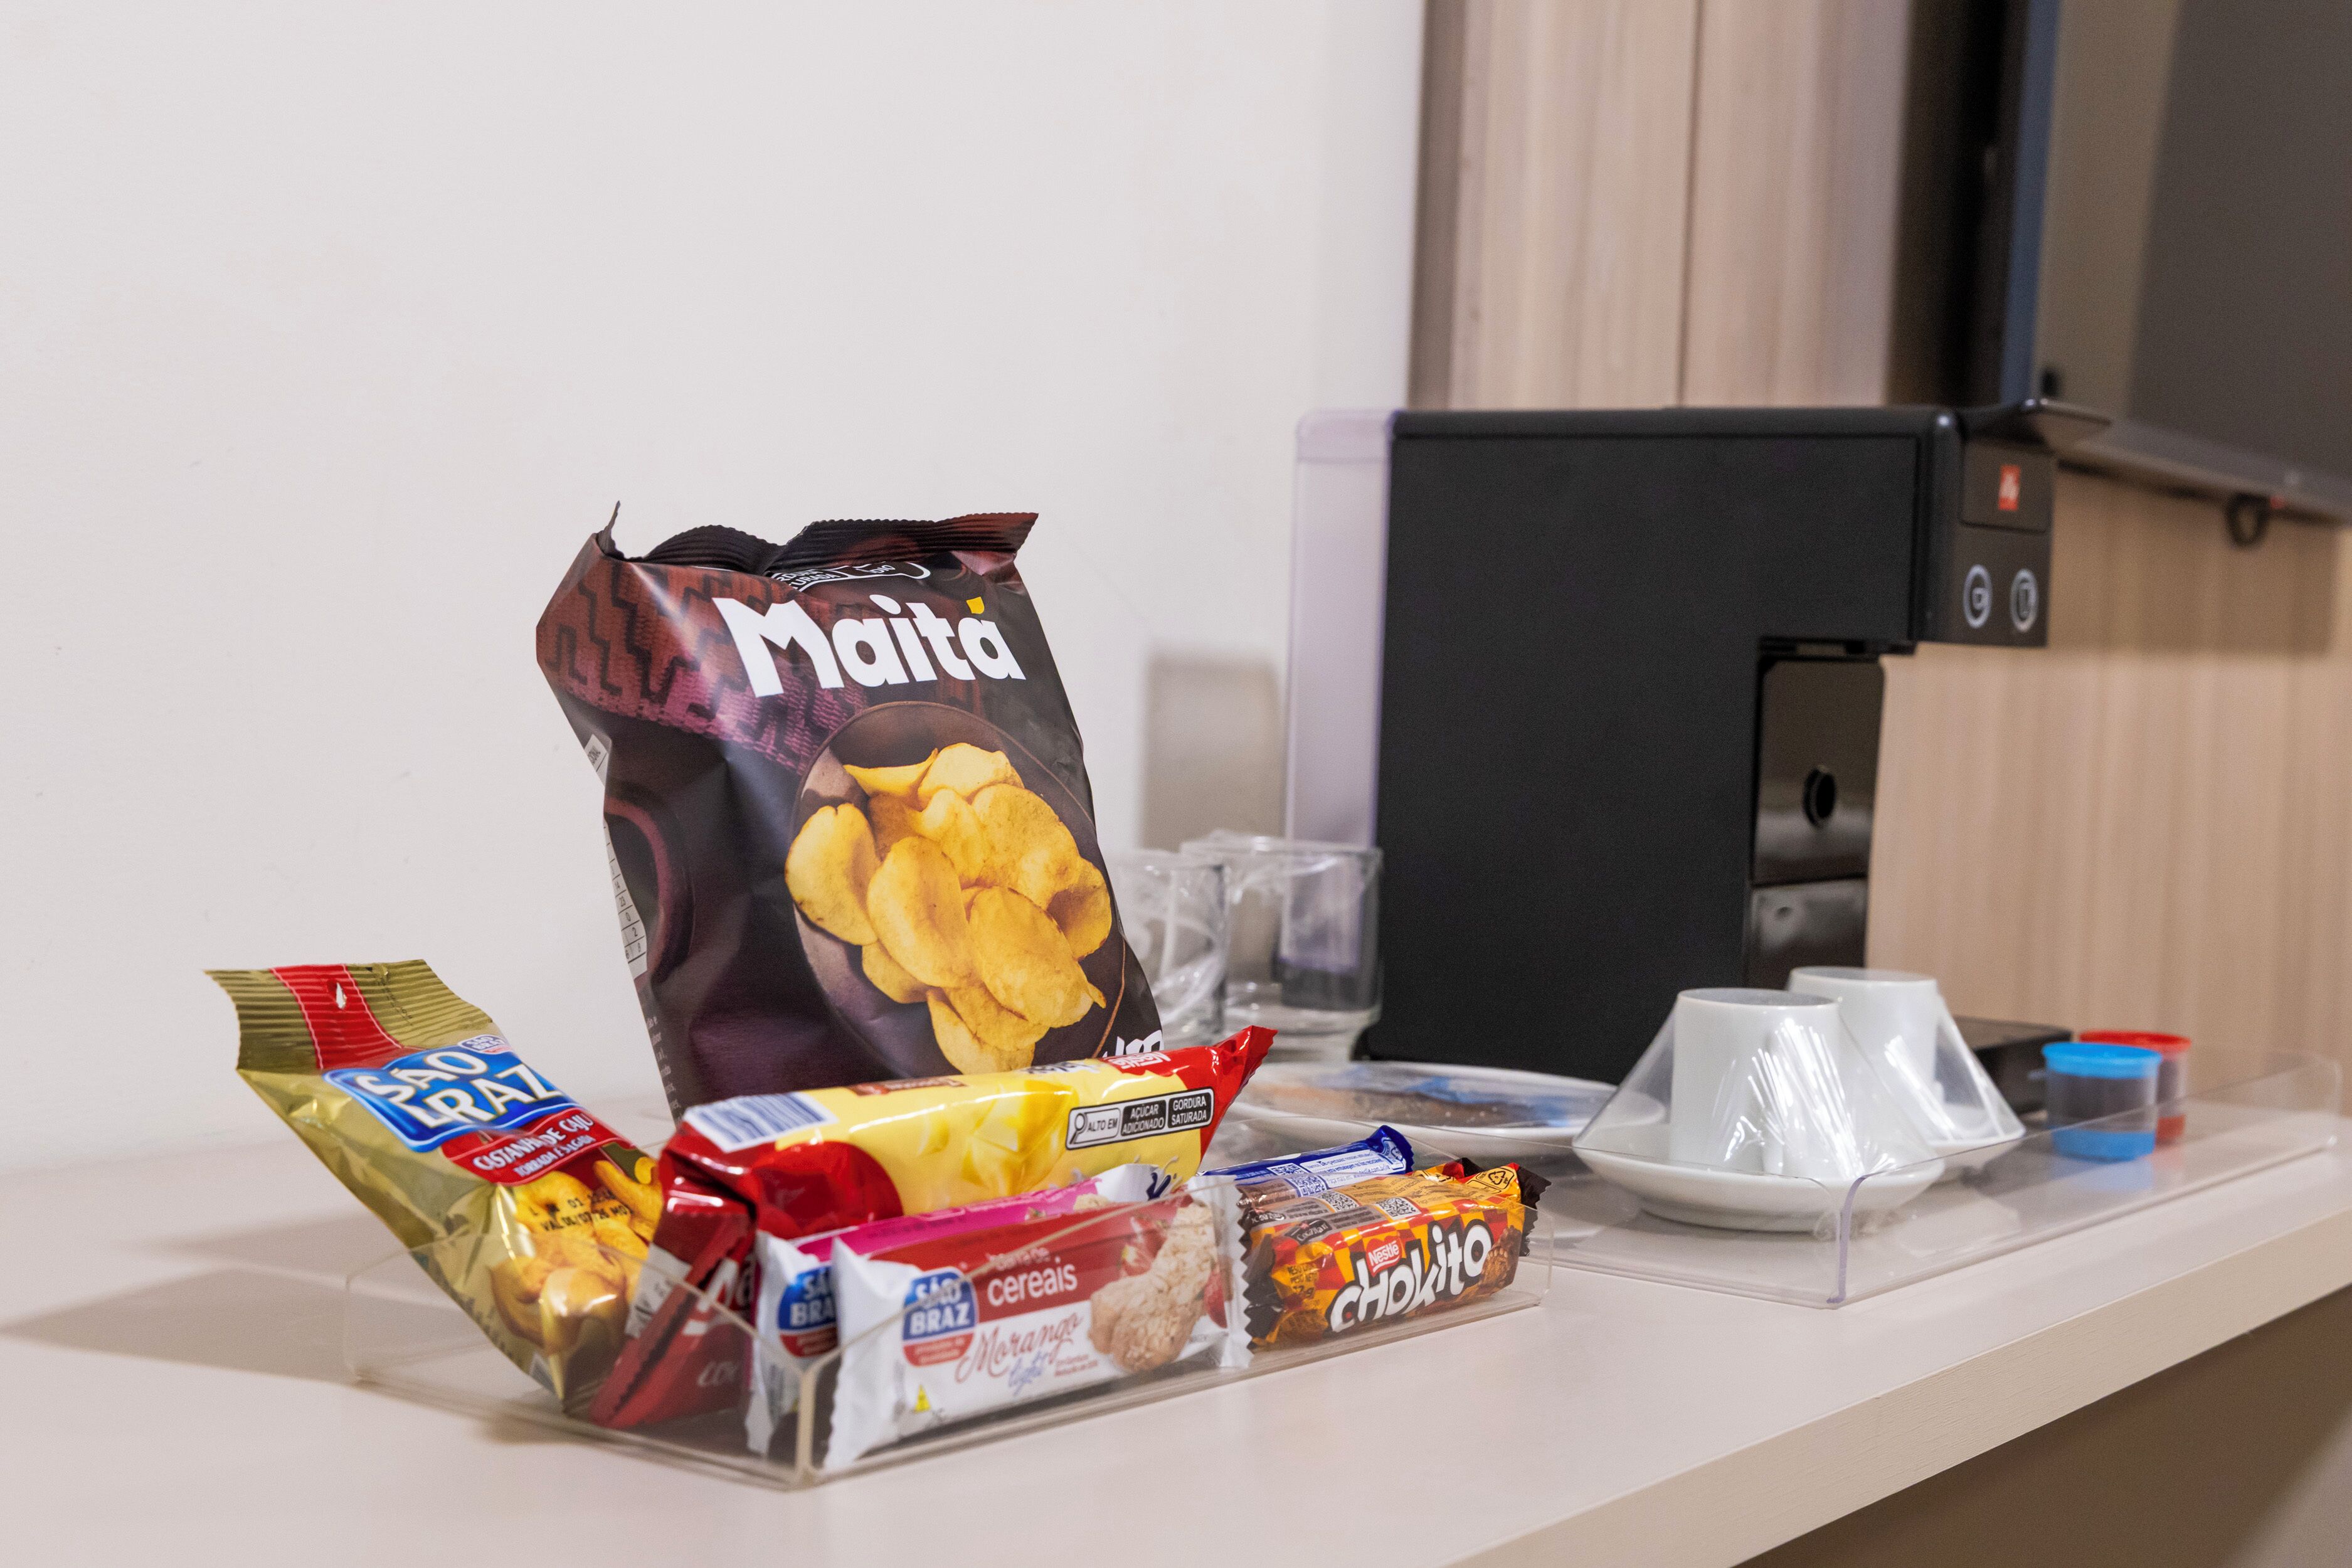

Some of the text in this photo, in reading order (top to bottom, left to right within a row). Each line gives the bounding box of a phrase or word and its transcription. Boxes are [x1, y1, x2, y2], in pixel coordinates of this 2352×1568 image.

[712, 595, 1026, 699] Maitá
[355, 1051, 489, 1104] SÃO
[1130, 1104, 1159, 1120] AÇÚCAR
[1173, 1096, 1207, 1111] GORDURA
[558, 1113, 594, 1133] CAJU
[1088, 1118, 1118, 1133] ALTO EM
[1121, 1117, 1165, 1135] ADICIONADO
[1171, 1110, 1207, 1126] SATURADA
[1367, 1239, 1400, 1266] Nestlé
[987, 1256, 1078, 1307] cereais
[790, 1297, 835, 1327] BRA
[909, 1302, 971, 1336] BRAZ
[954, 1312, 1085, 1385] Morango
